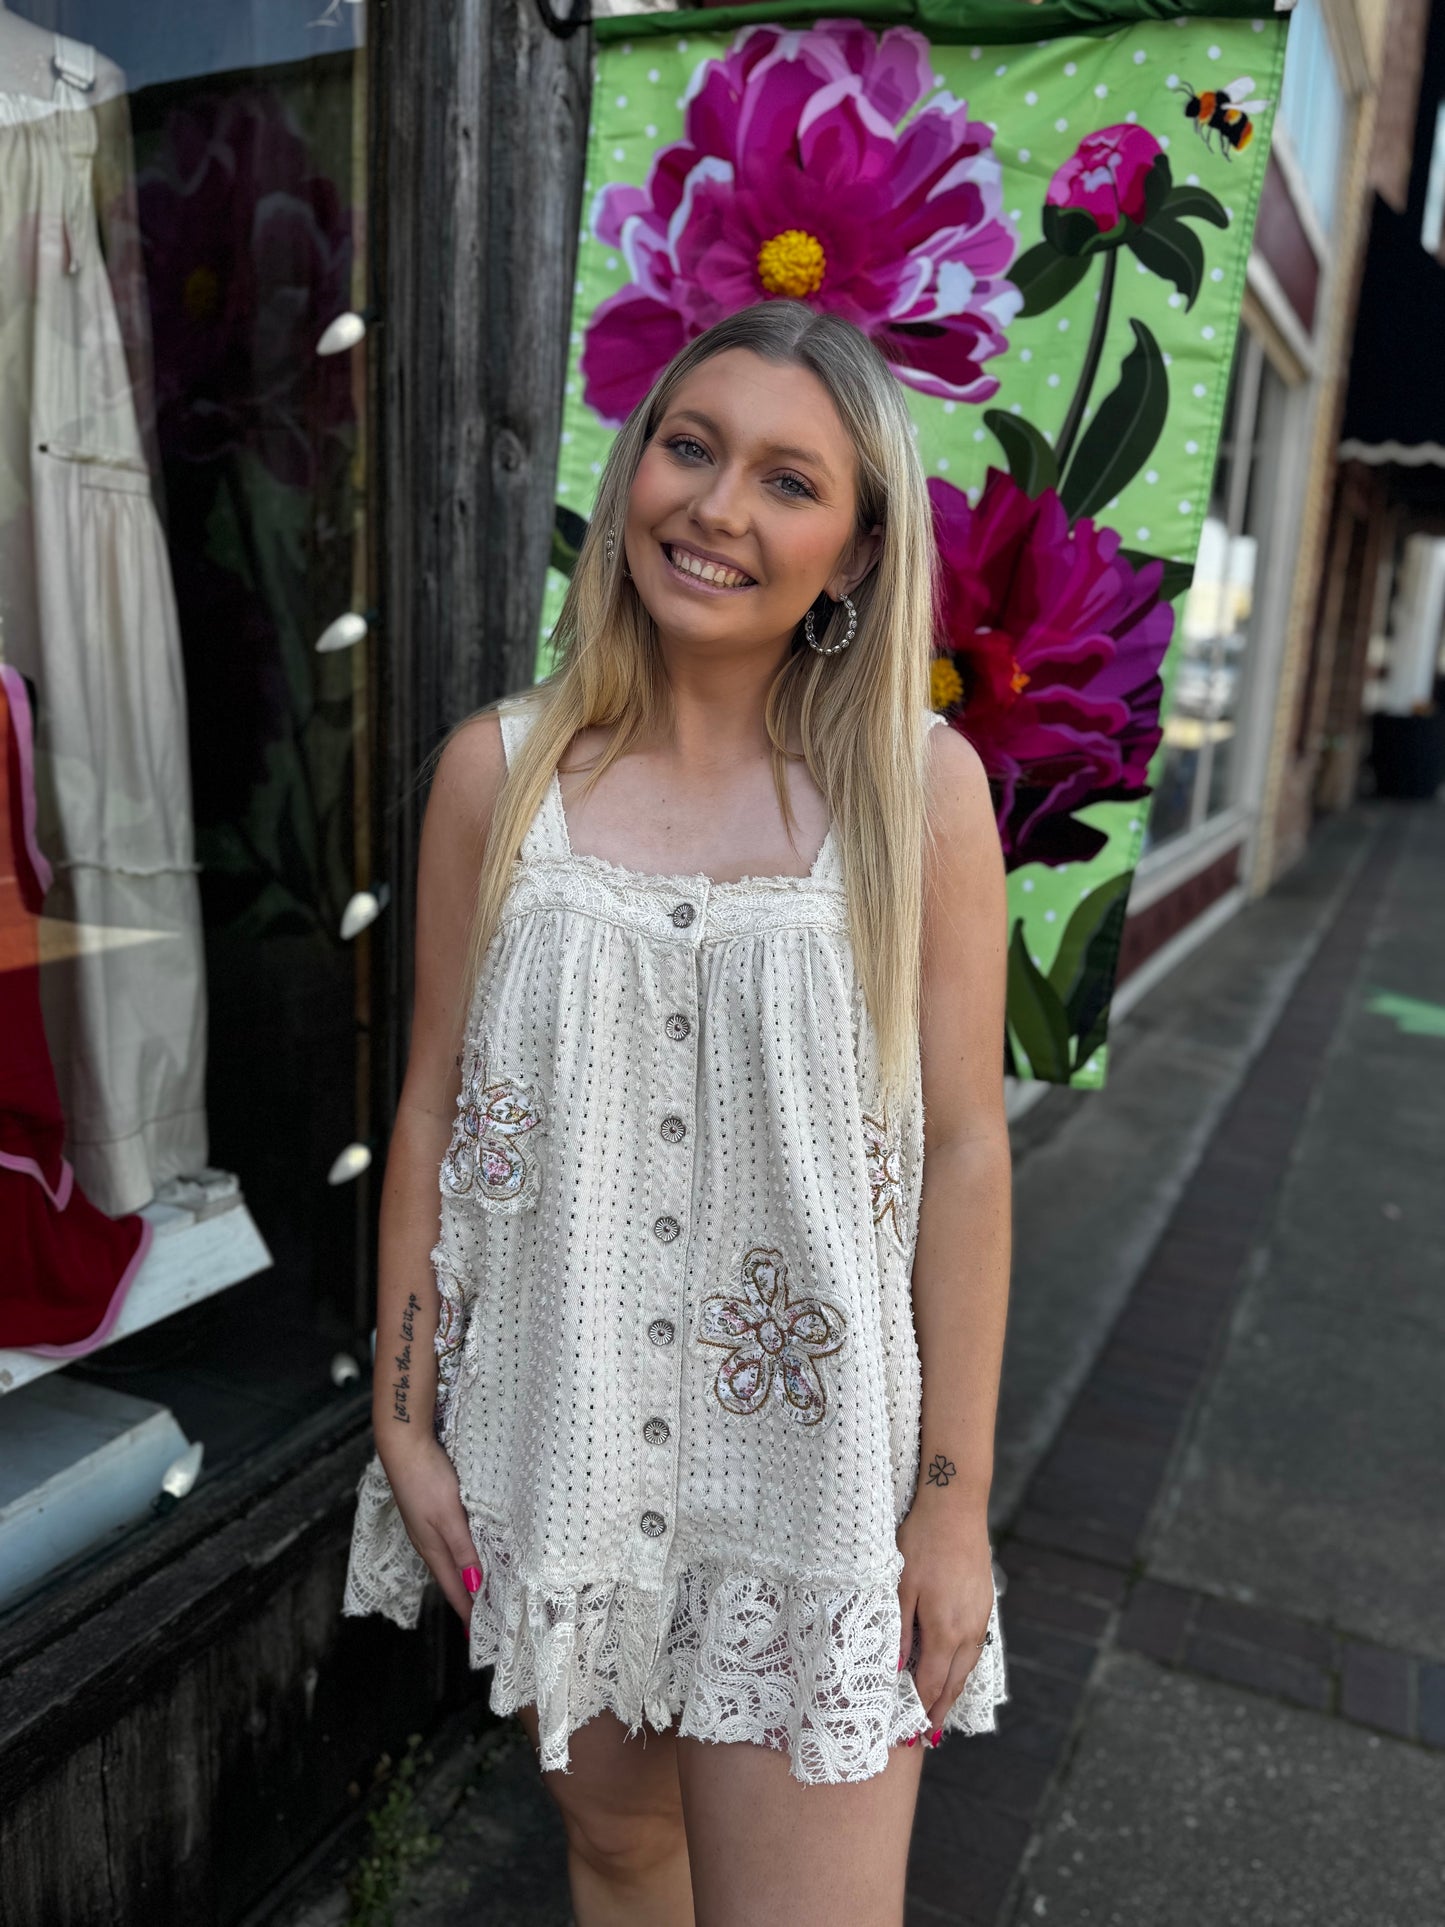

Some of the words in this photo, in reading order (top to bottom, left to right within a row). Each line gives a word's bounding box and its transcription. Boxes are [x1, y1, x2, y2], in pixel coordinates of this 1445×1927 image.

[408, 1292, 421, 1311] go
[402, 1309, 414, 1322] it
[399, 1322, 414, 1342] let
[395, 1344, 411, 1371] then
[395, 1389, 407, 1402] it
[393, 1403, 410, 1423] Let
